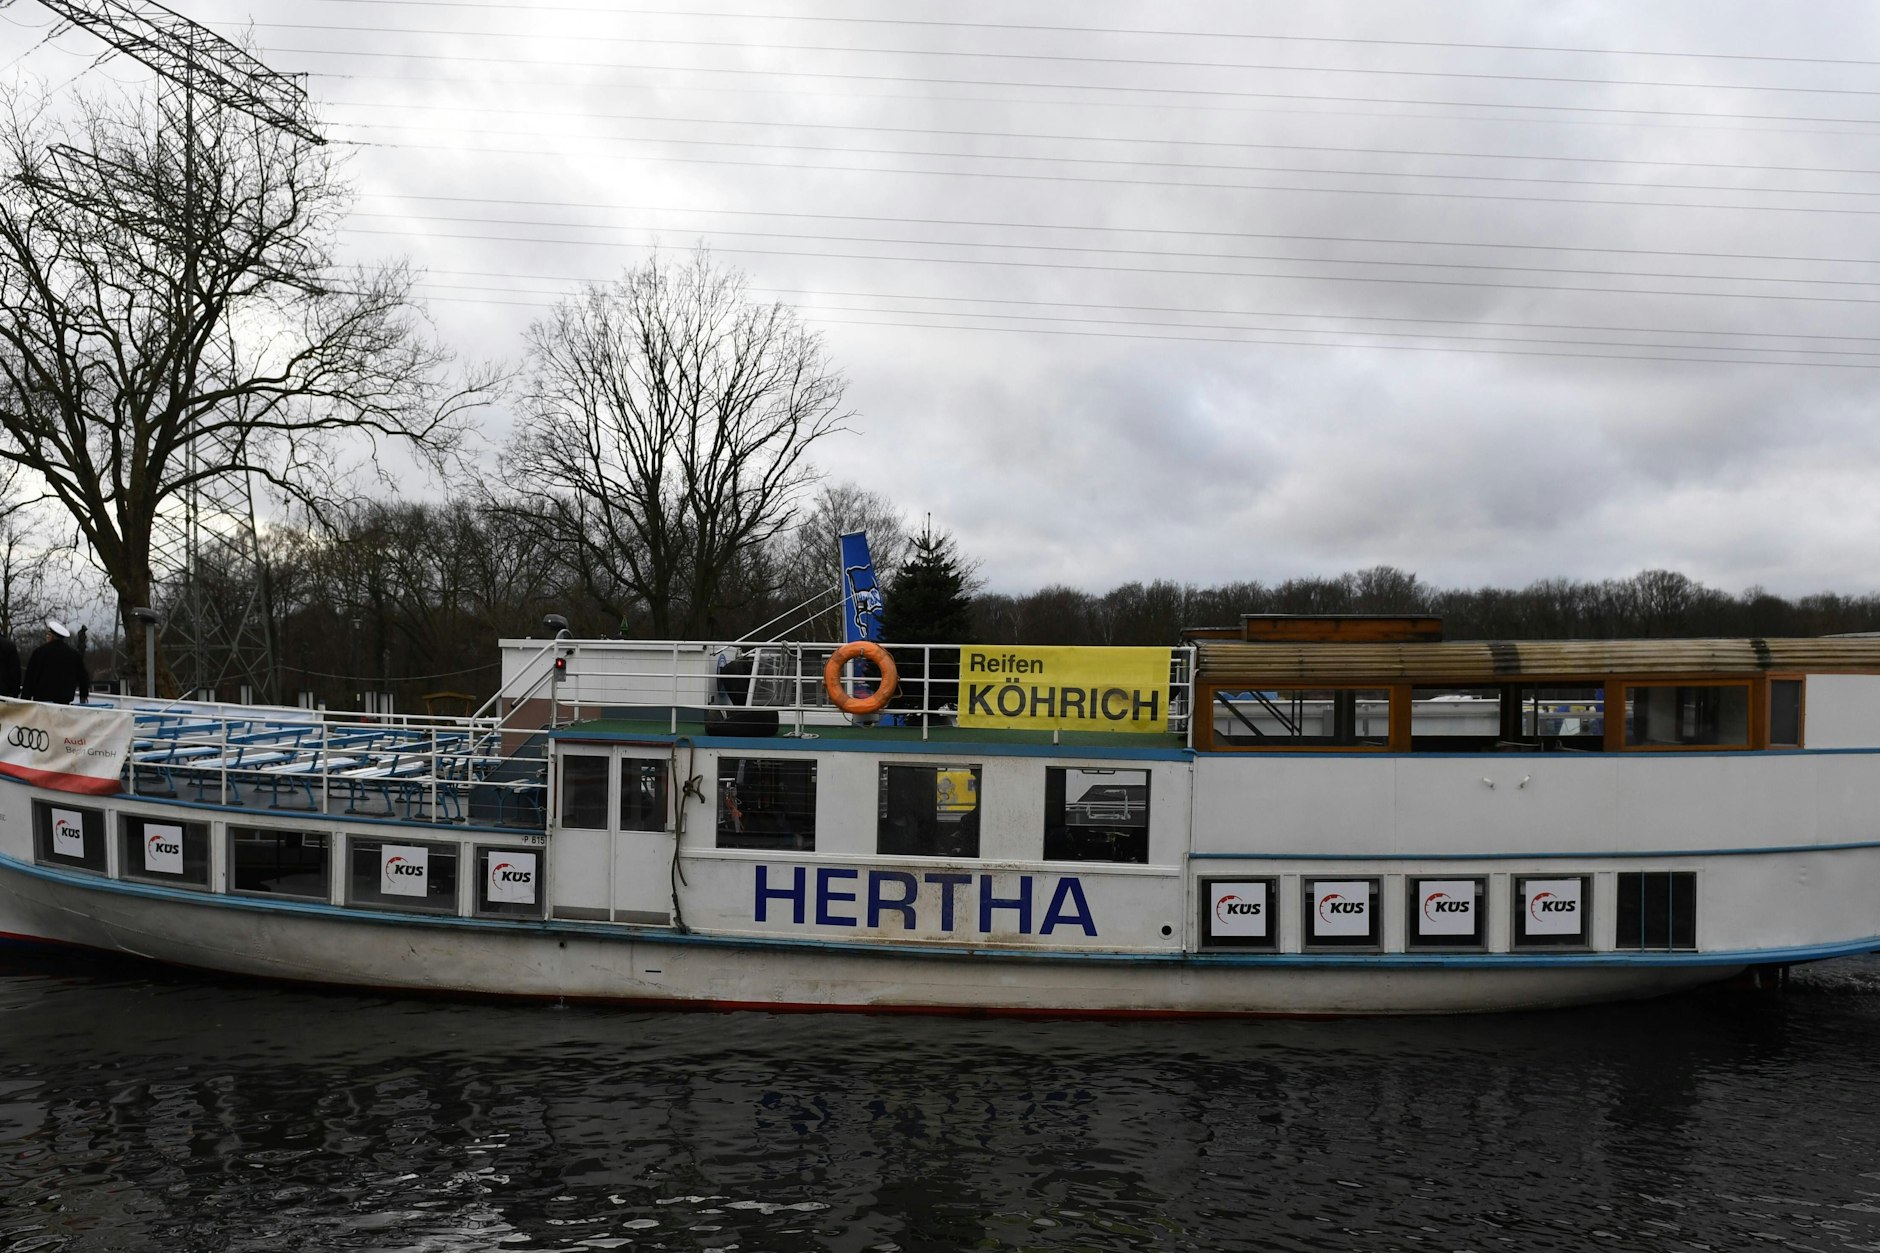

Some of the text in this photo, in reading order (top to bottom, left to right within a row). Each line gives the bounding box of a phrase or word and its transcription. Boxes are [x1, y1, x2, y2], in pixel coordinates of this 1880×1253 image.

[969, 652, 1044, 675] Reifen
[967, 677, 1159, 721] KÖHRICH
[63, 736, 87, 746] Audi
[87, 748, 117, 758] GmbH
[61, 826, 81, 839] KÜS
[531, 835, 545, 845] 615
[155, 842, 180, 855] KÜS
[394, 864, 424, 877] KÜS
[501, 870, 532, 883] KÜS
[754, 864, 1098, 938] HERTHA
[1435, 900, 1470, 913] KÜS
[1541, 900, 1577, 912] KÜS
[1226, 903, 1262, 915] KÜS
[1330, 902, 1365, 914] KÜS
